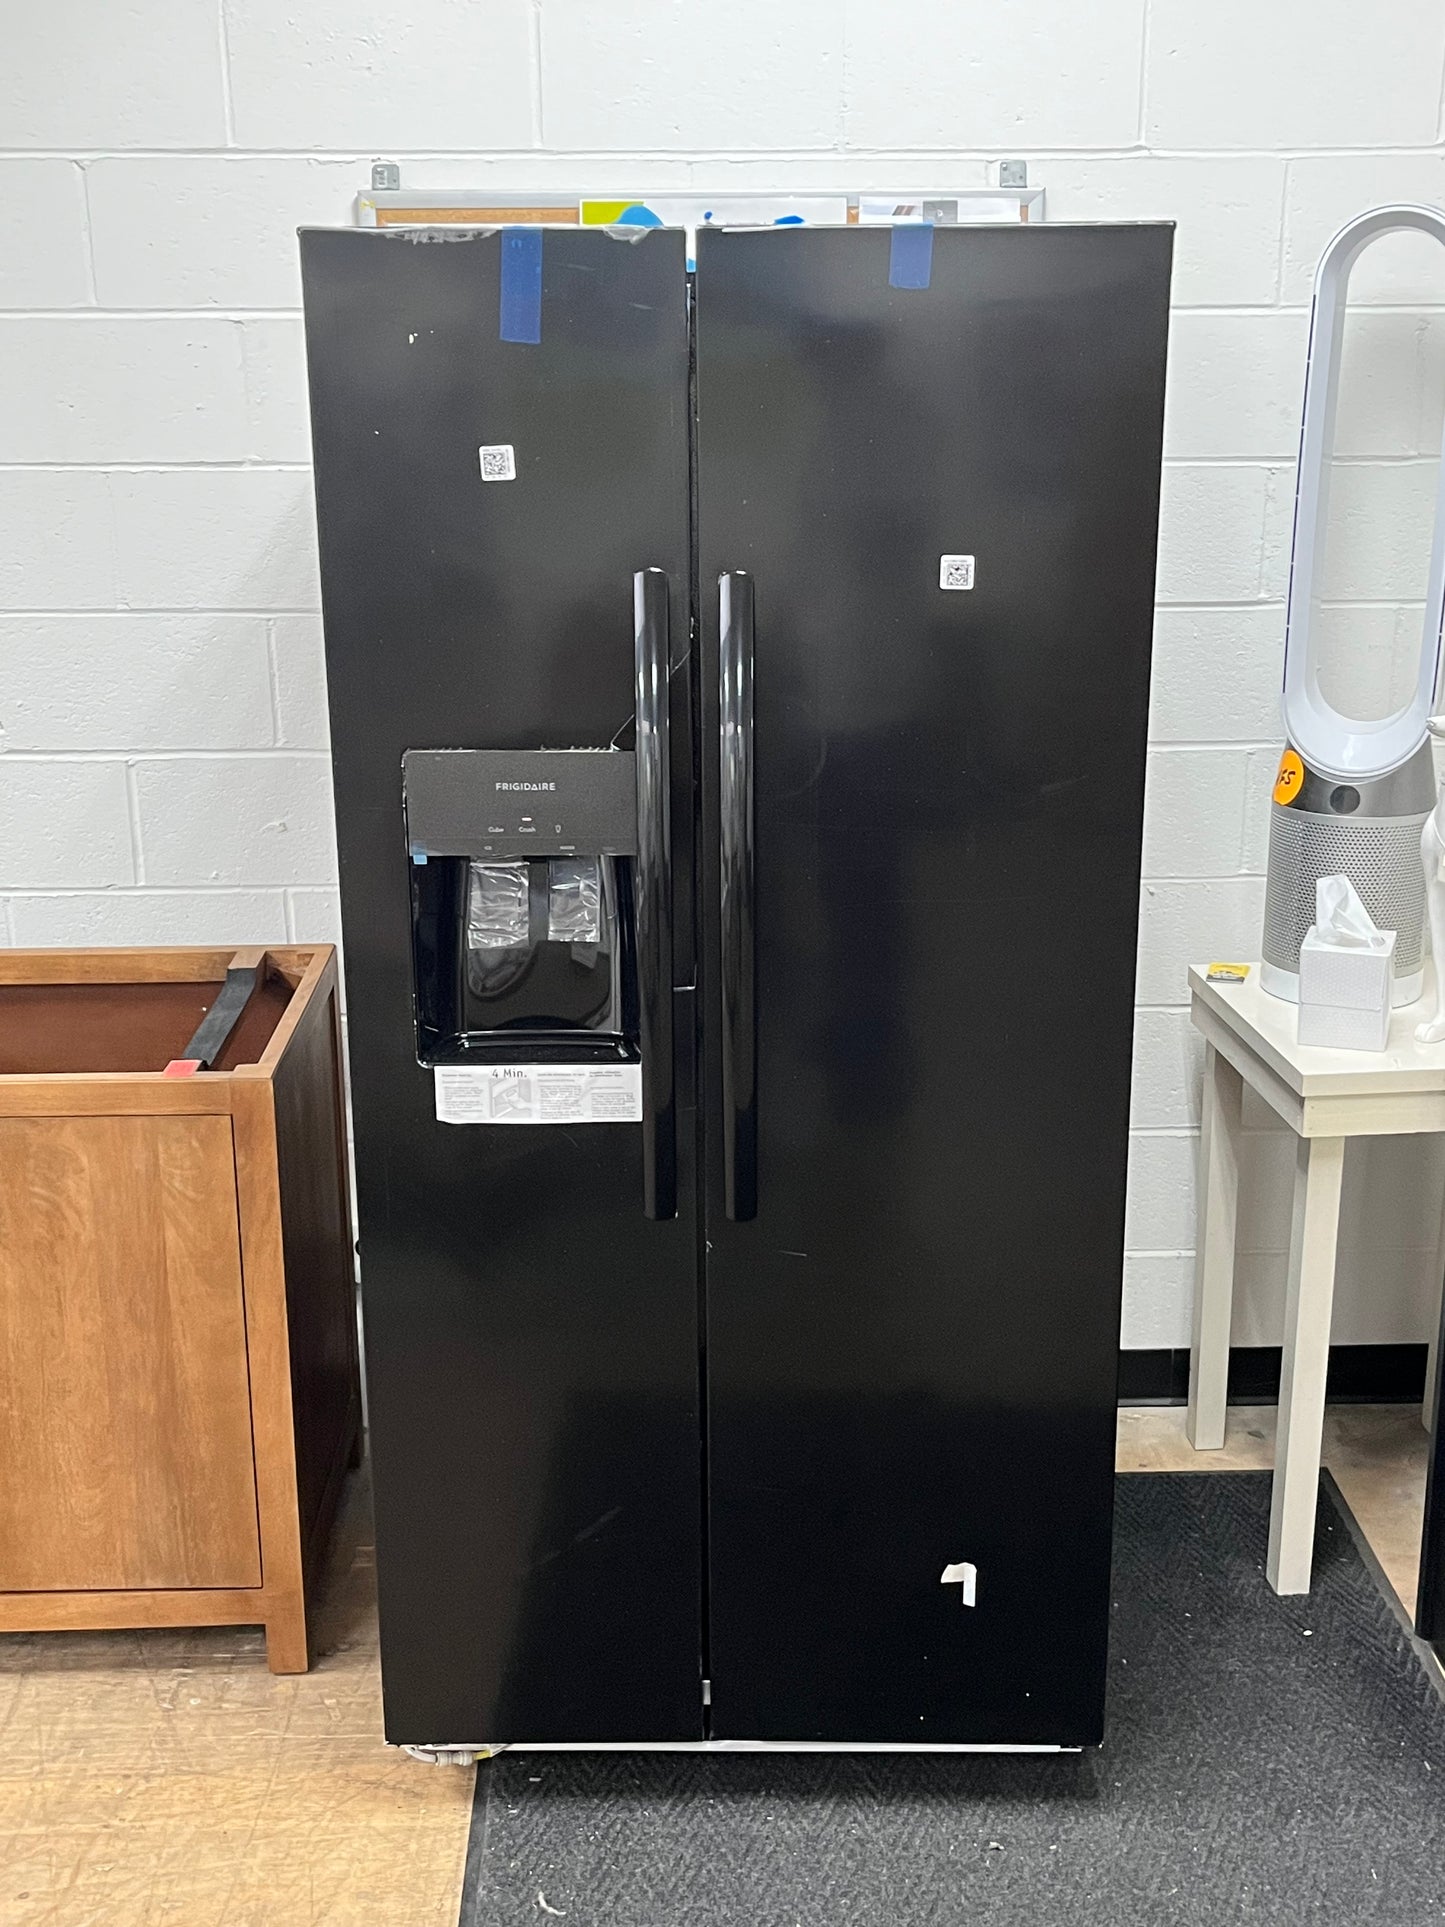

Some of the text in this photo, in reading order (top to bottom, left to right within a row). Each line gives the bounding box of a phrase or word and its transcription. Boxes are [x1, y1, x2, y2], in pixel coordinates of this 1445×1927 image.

[495, 782, 556, 791] FRIGIDAIRE
[492, 1069, 499, 1079] 4
[503, 1068, 528, 1079] Min.
